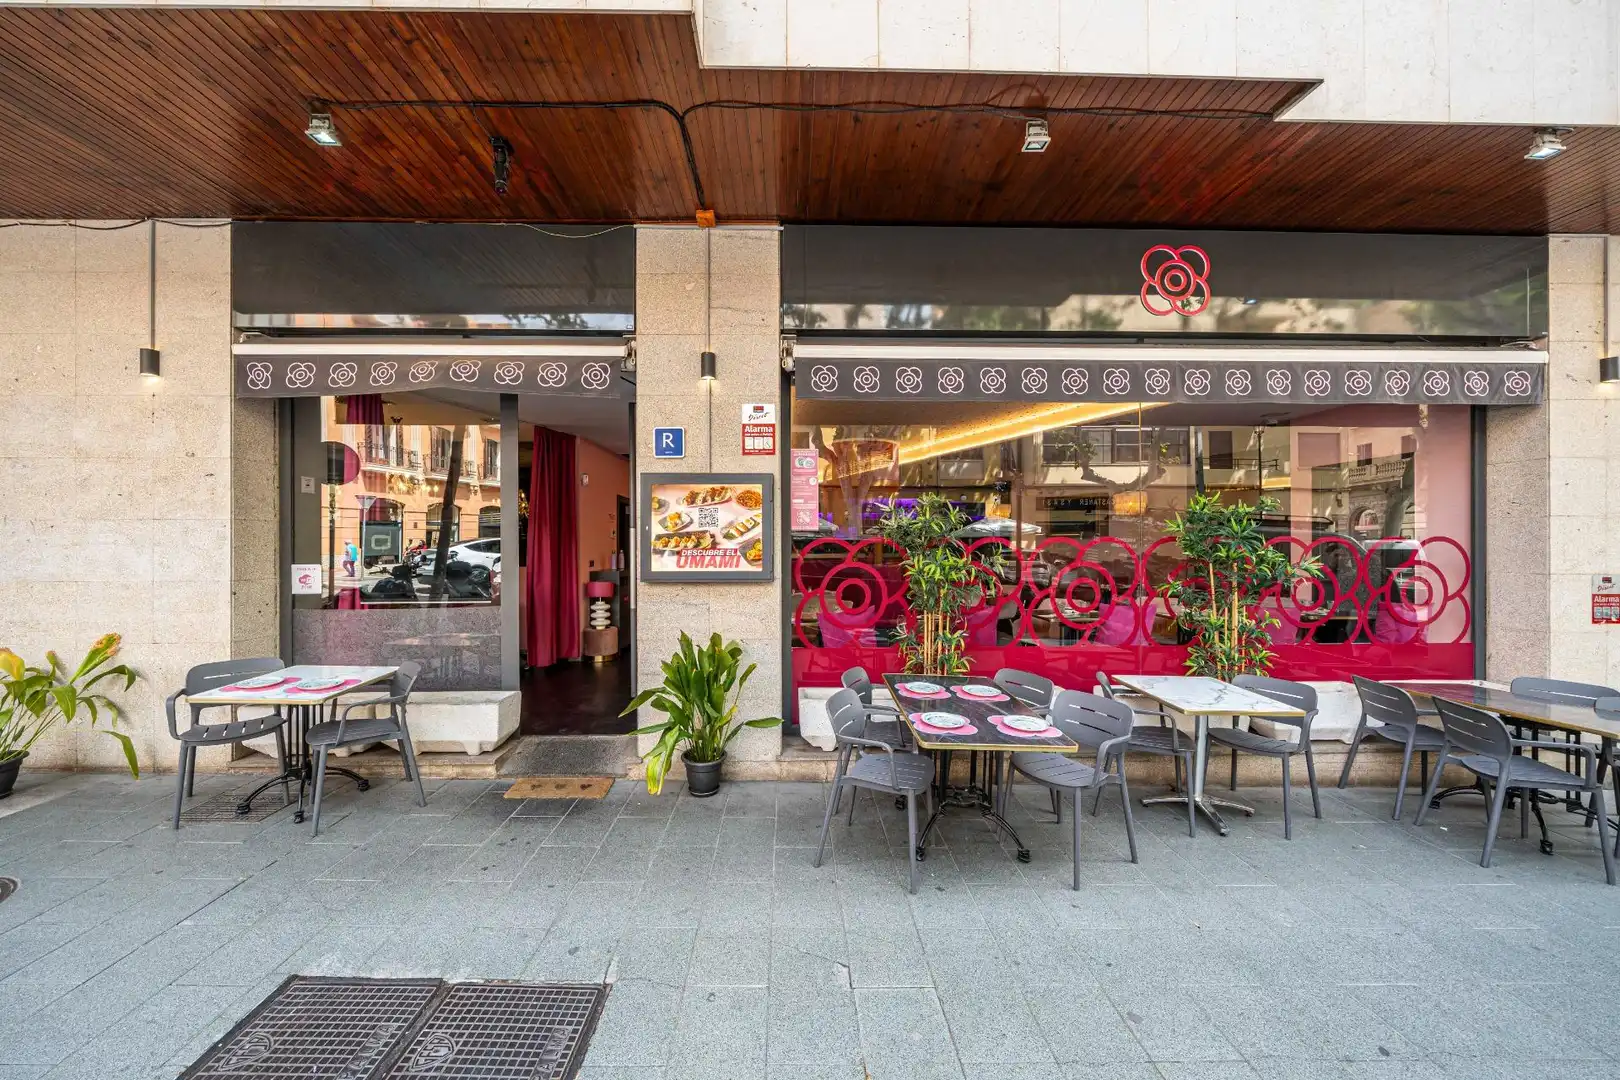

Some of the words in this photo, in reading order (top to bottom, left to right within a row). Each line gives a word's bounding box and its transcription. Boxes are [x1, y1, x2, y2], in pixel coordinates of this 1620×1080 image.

[744, 425, 773, 433] Alarma
[662, 432, 674, 448] R
[676, 556, 741, 568] UMAMI
